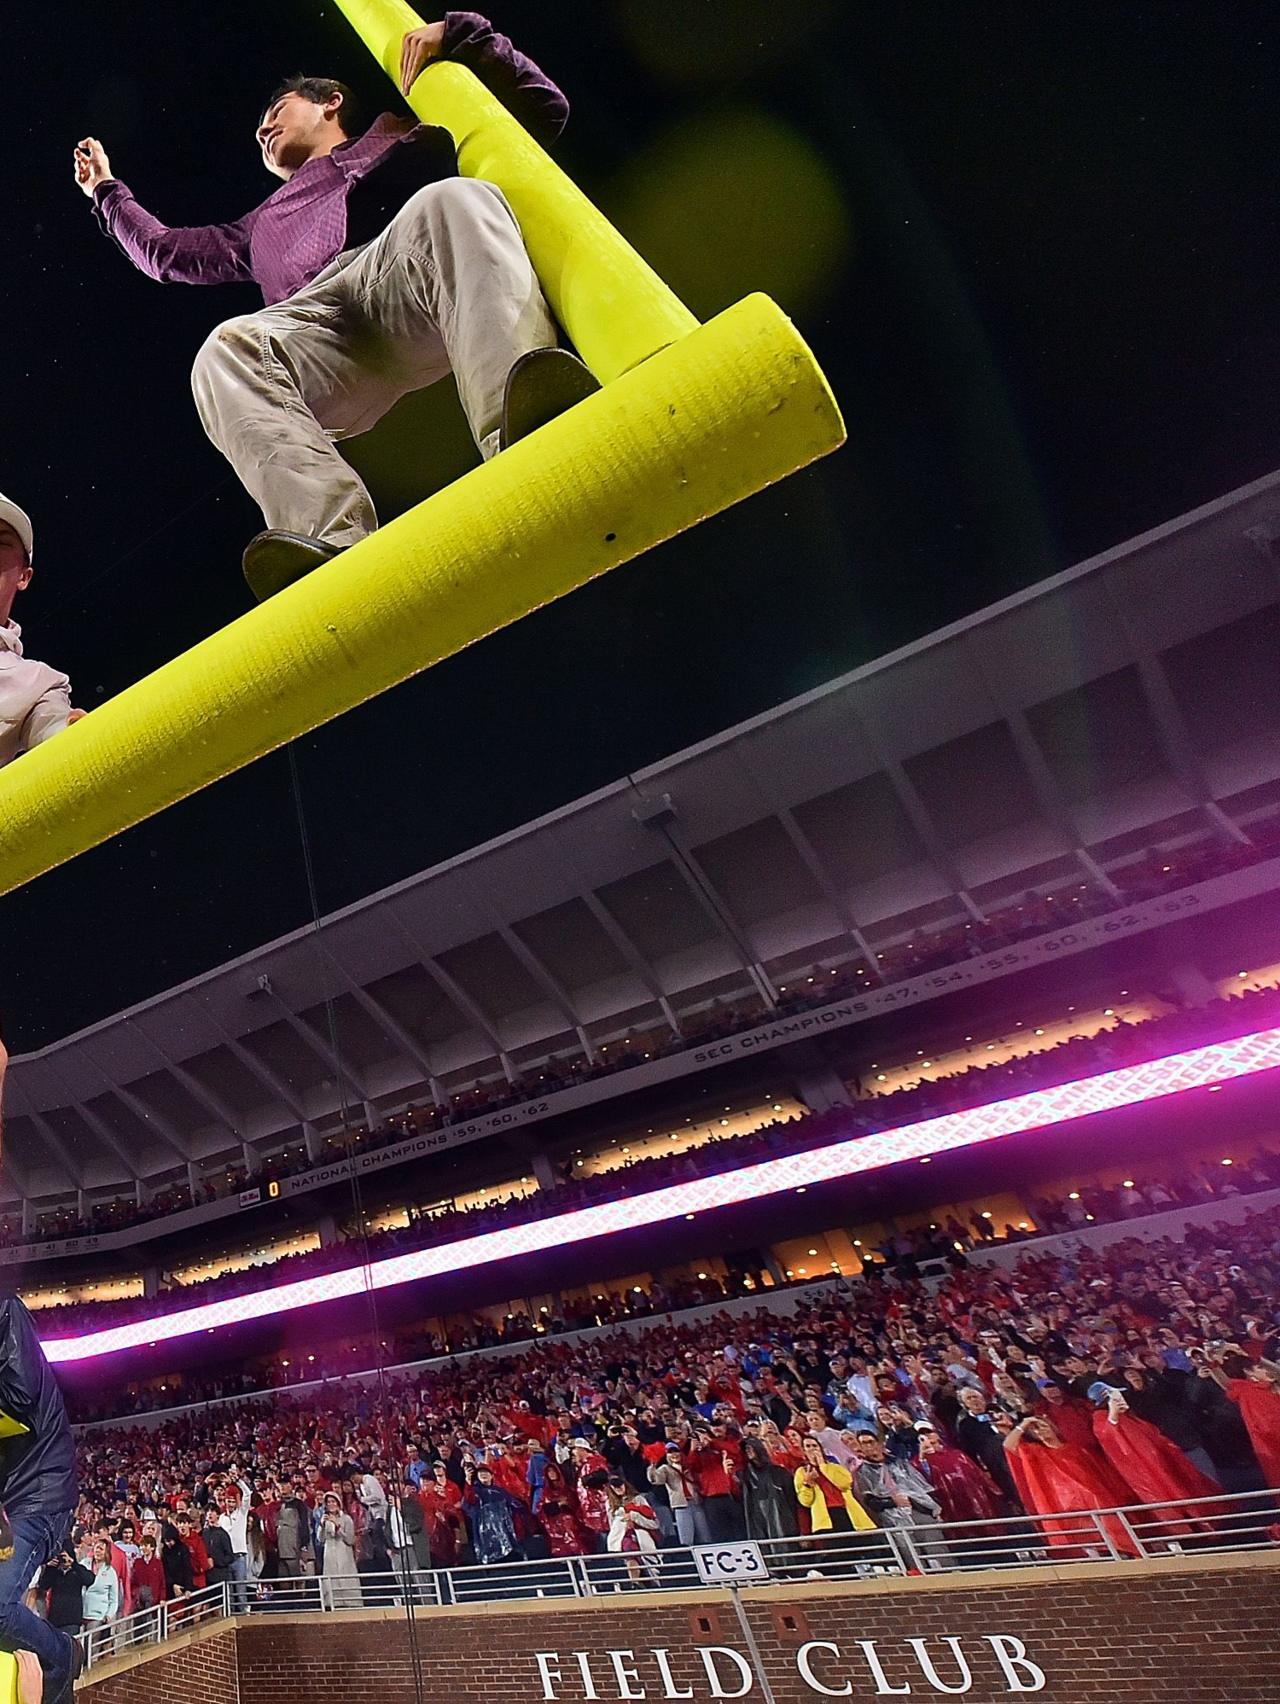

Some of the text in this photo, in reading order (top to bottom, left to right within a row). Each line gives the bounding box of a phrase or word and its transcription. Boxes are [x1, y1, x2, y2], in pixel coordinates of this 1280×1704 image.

[694, 1044, 734, 1064] SEC
[740, 1002, 869, 1049] CHAMPIONS
[268, 1181, 279, 1198] 0
[291, 1164, 358, 1191] NATIONAL
[362, 1134, 448, 1168] CHAMPIONS
[703, 1549, 760, 1576] FC-3
[535, 1634, 1047, 1700] FIELD CLUB
